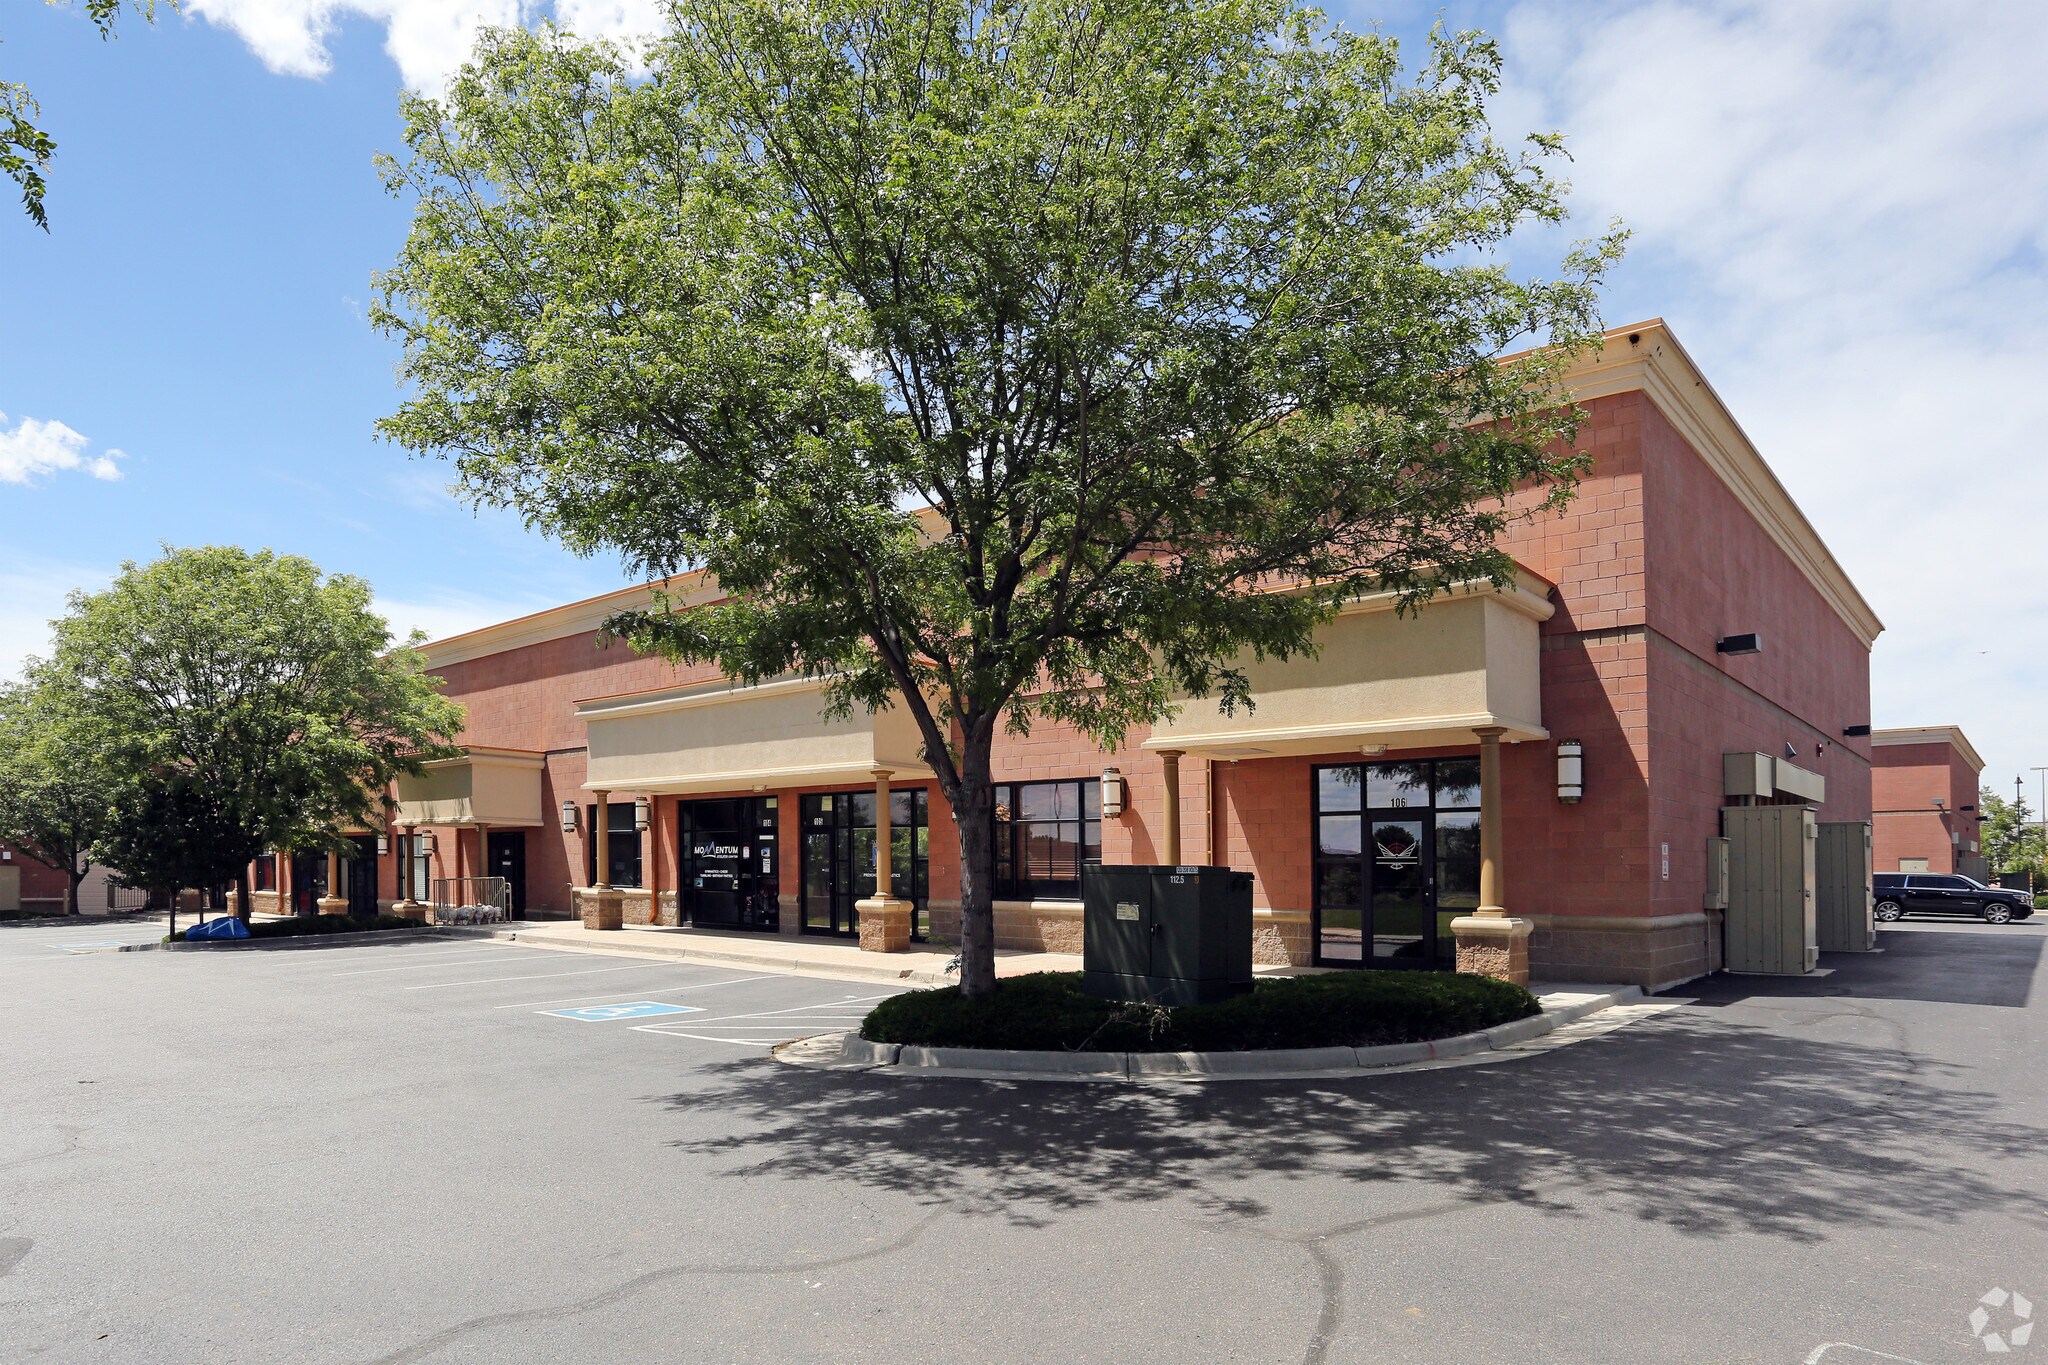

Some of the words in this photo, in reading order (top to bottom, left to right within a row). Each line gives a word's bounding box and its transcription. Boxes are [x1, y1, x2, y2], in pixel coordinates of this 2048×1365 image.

[1391, 797, 1406, 808] 106
[694, 841, 738, 856] MOMENTUM
[1170, 876, 1184, 884] 112.5
